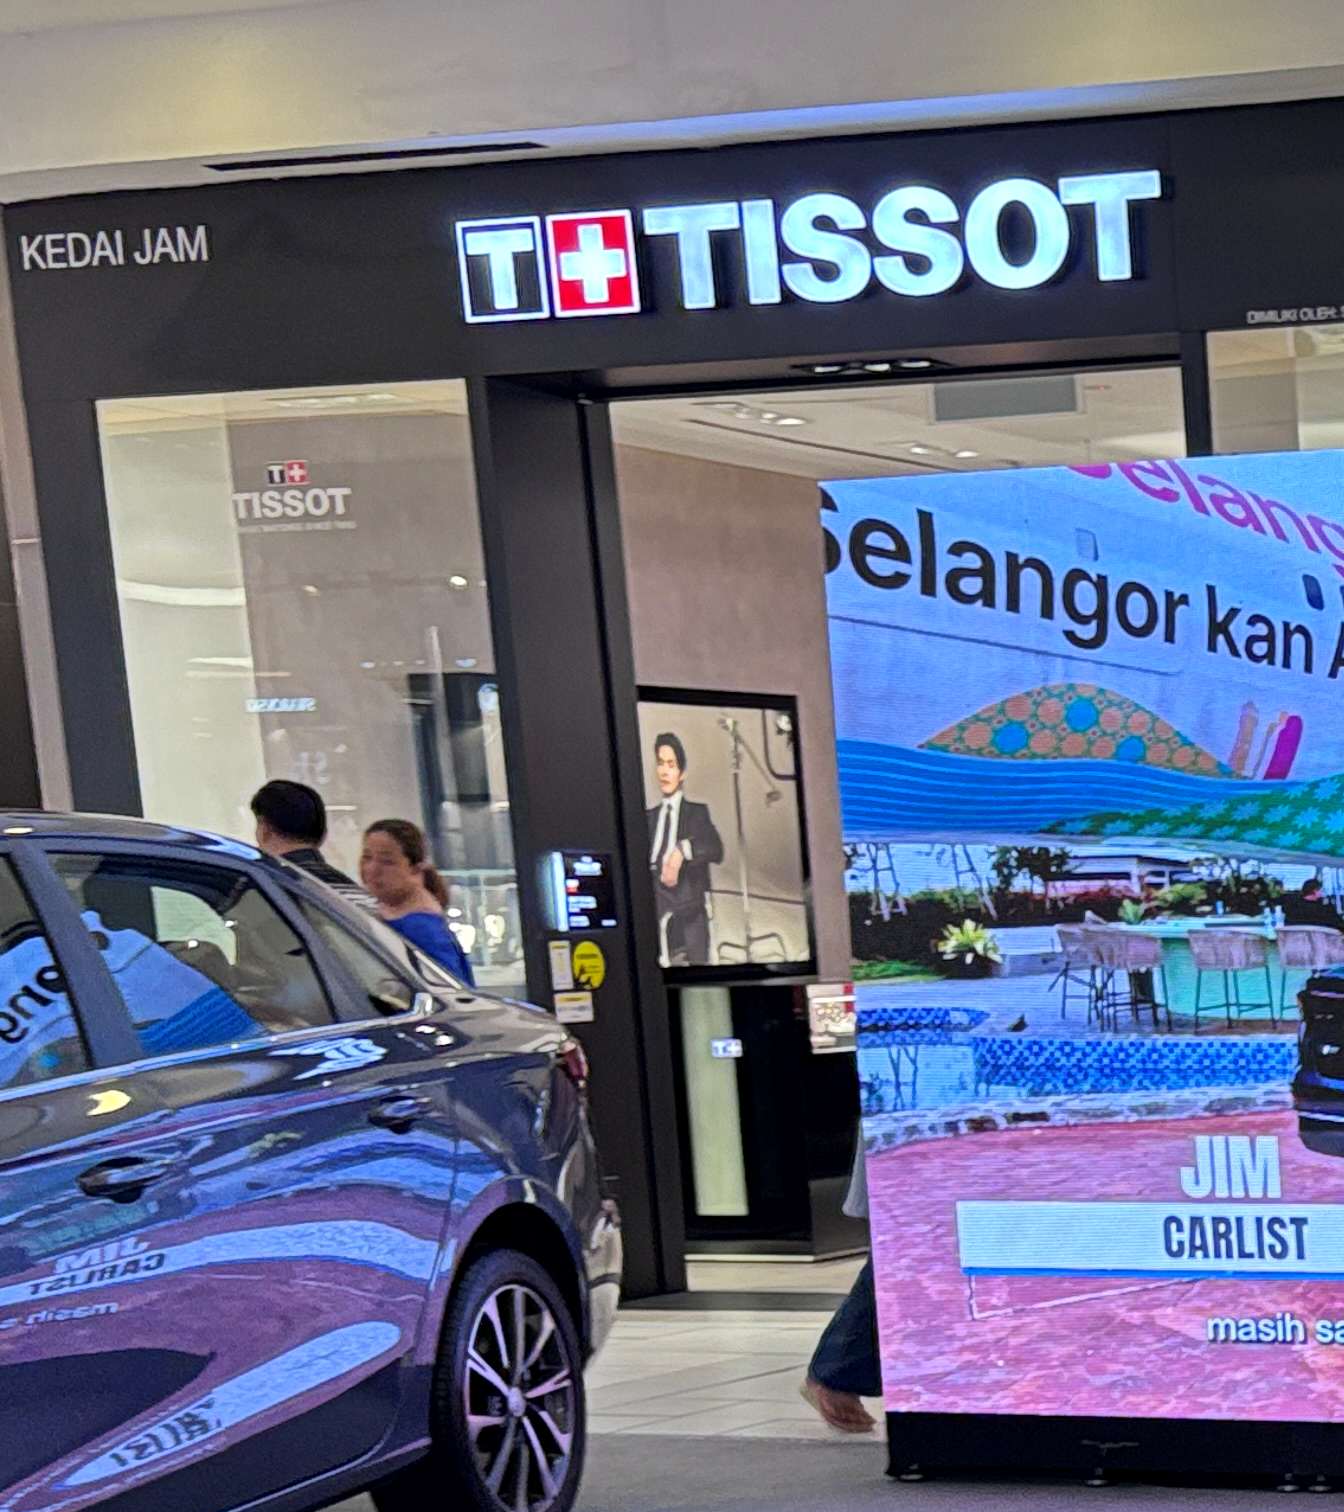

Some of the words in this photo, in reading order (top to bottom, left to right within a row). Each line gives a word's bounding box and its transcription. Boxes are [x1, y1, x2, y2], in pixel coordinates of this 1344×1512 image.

[20, 231, 126, 270] KEDAI
[134, 225, 209, 265] JAM
[642, 169, 1162, 310] TISSOT
[232, 487, 352, 519] TISSOT
[1205, 584, 1314, 675] kan
[1180, 1135, 1281, 1199] JIM
[1163, 1215, 1308, 1260] CARLIST
[1208, 1312, 1304, 1346] masih
